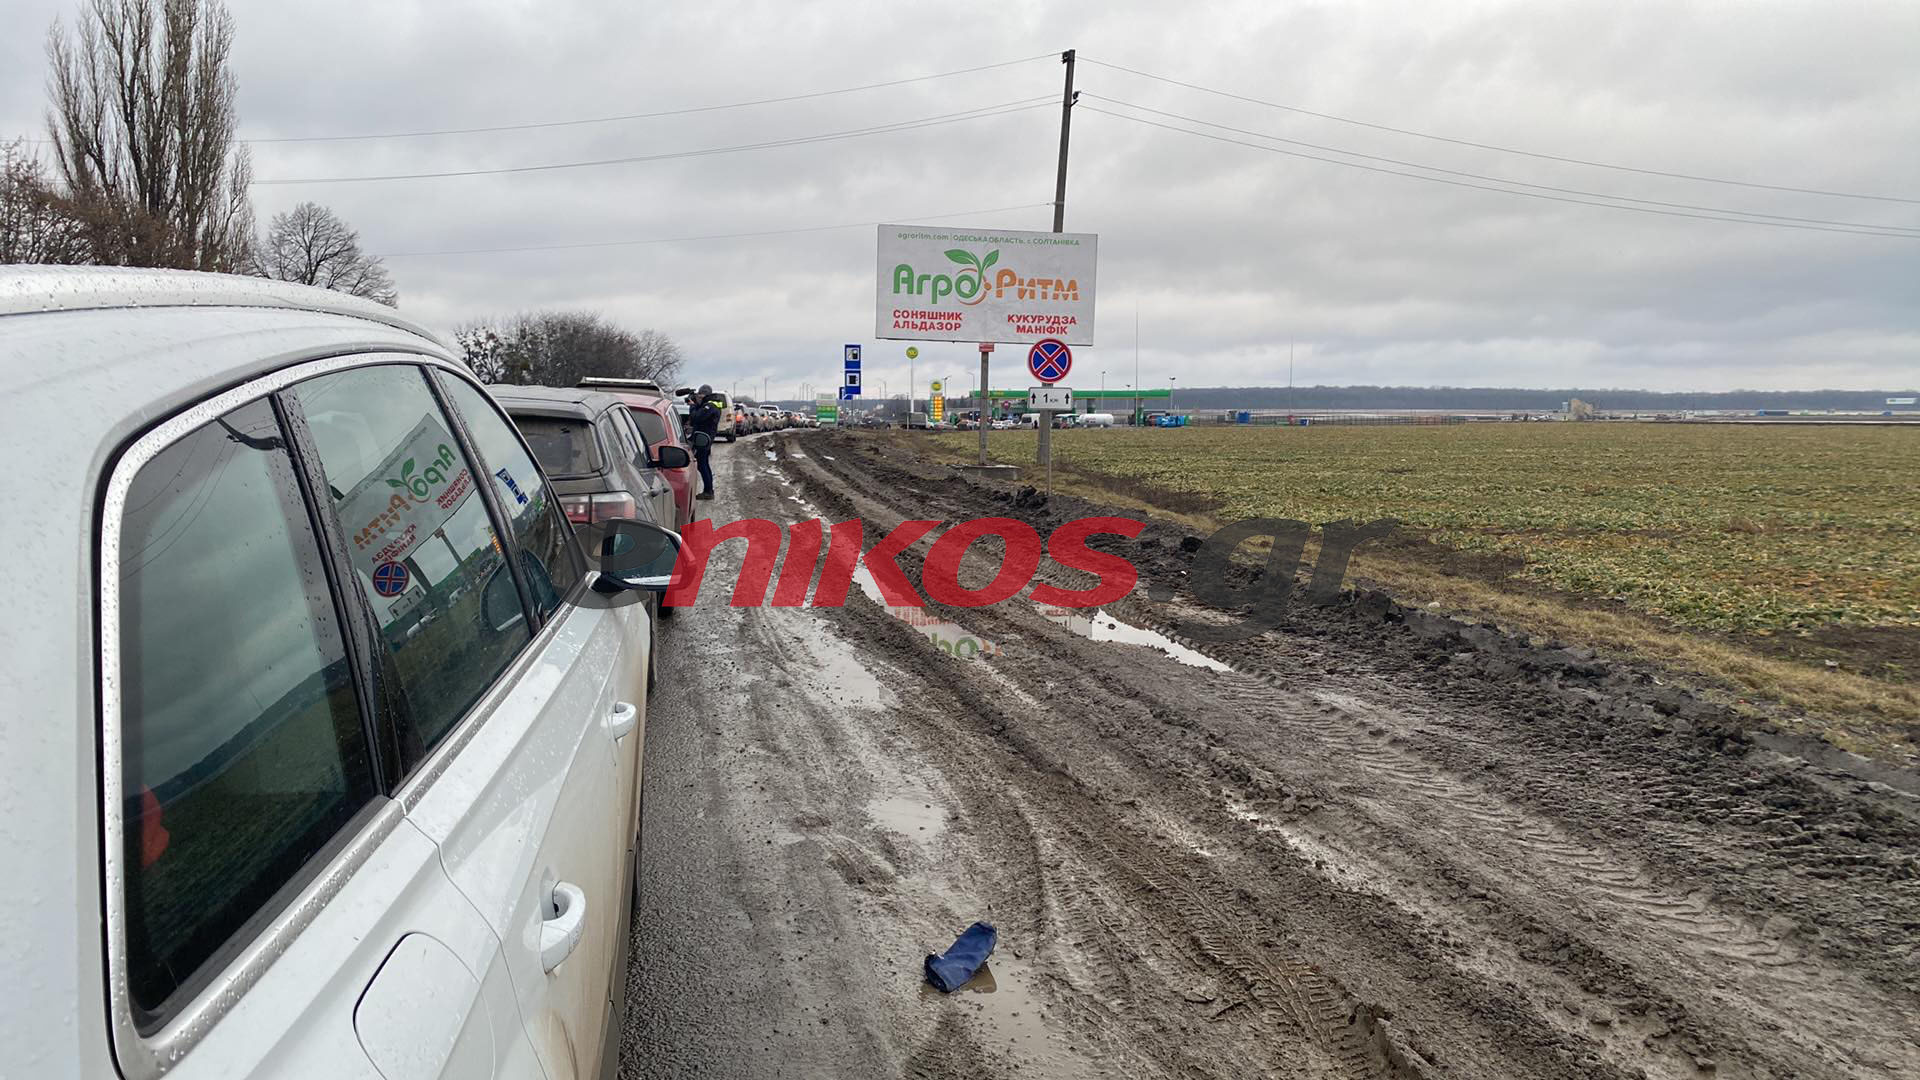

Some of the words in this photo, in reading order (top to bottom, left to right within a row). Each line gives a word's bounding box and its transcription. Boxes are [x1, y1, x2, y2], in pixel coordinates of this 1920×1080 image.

[897, 232, 949, 241] agroritm.com
[893, 309, 963, 321] СОНЯШНИК
[1007, 313, 1077, 326] КУКУРУДЗА
[893, 320, 961, 332] АЛЬДАЗОР
[1016, 325, 1068, 335] МАНІФІК
[1043, 393, 1048, 403] 1
